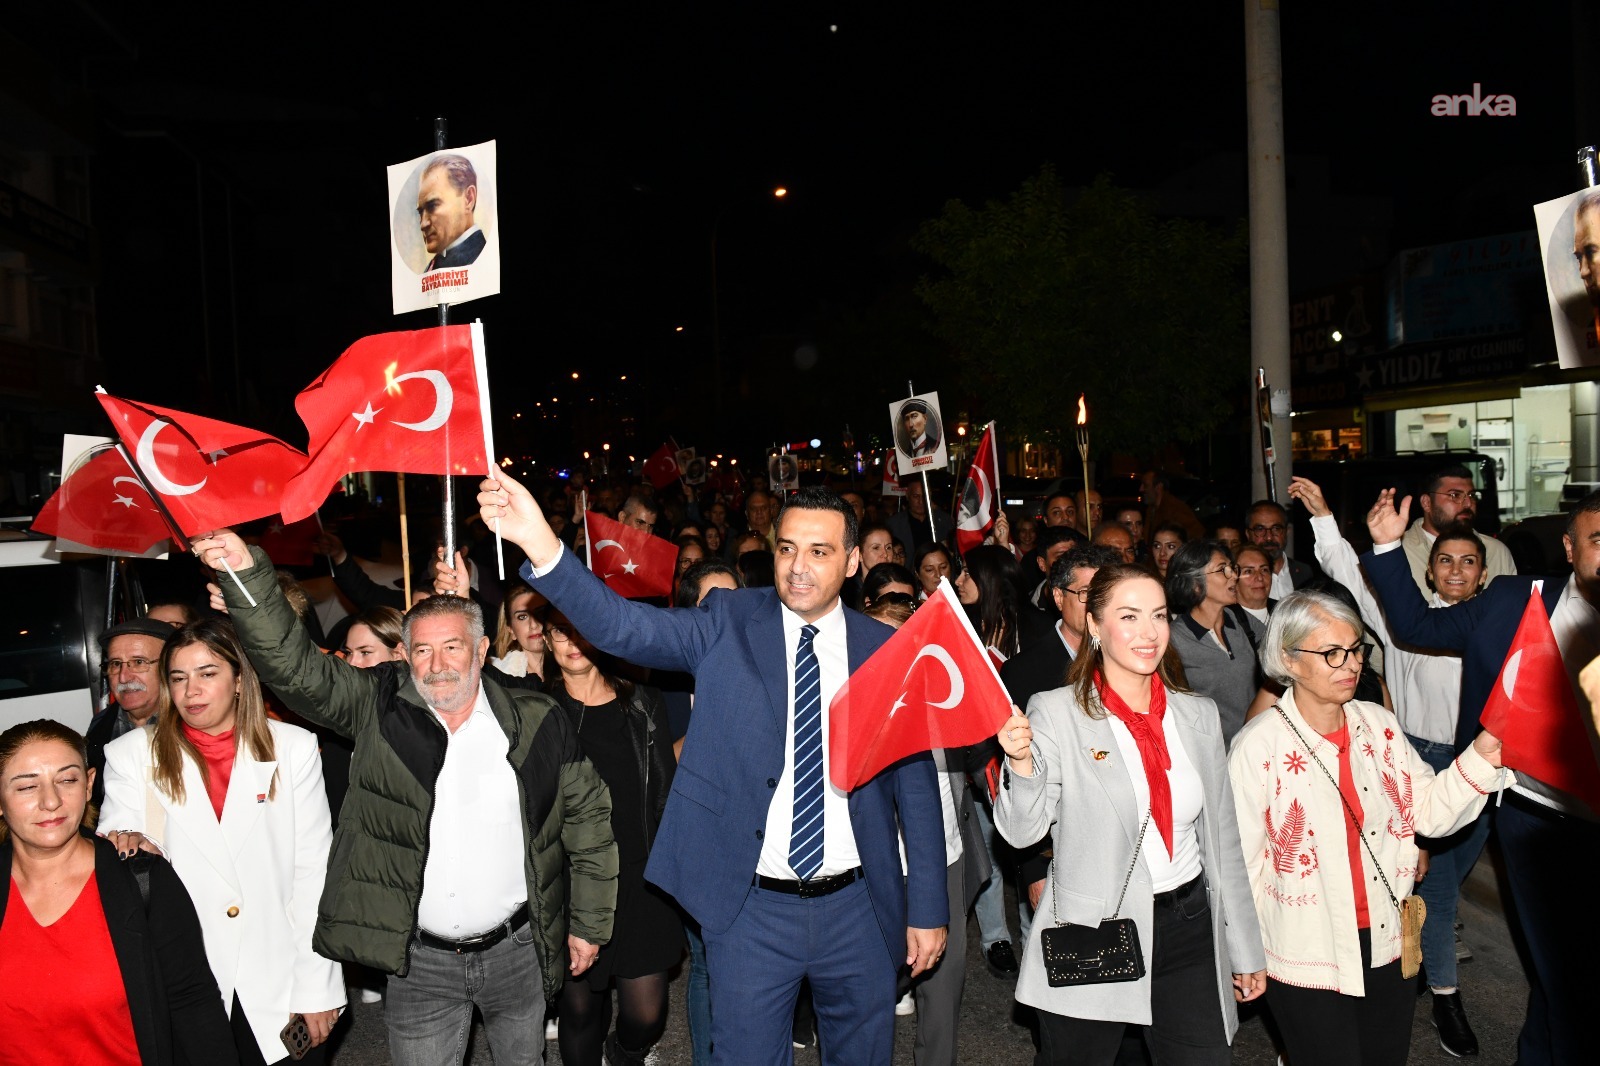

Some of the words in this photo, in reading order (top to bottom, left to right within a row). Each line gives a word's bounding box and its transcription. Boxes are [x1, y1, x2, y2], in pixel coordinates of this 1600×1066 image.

[1451, 237, 1539, 262] YILDI
[421, 269, 468, 285] CUMHURİYET
[421, 277, 468, 293] BAYRAMIMIZ
[1291, 294, 1336, 329] ENT
[1376, 350, 1444, 386] YILDIZ
[1469, 338, 1525, 360] CLEANING
